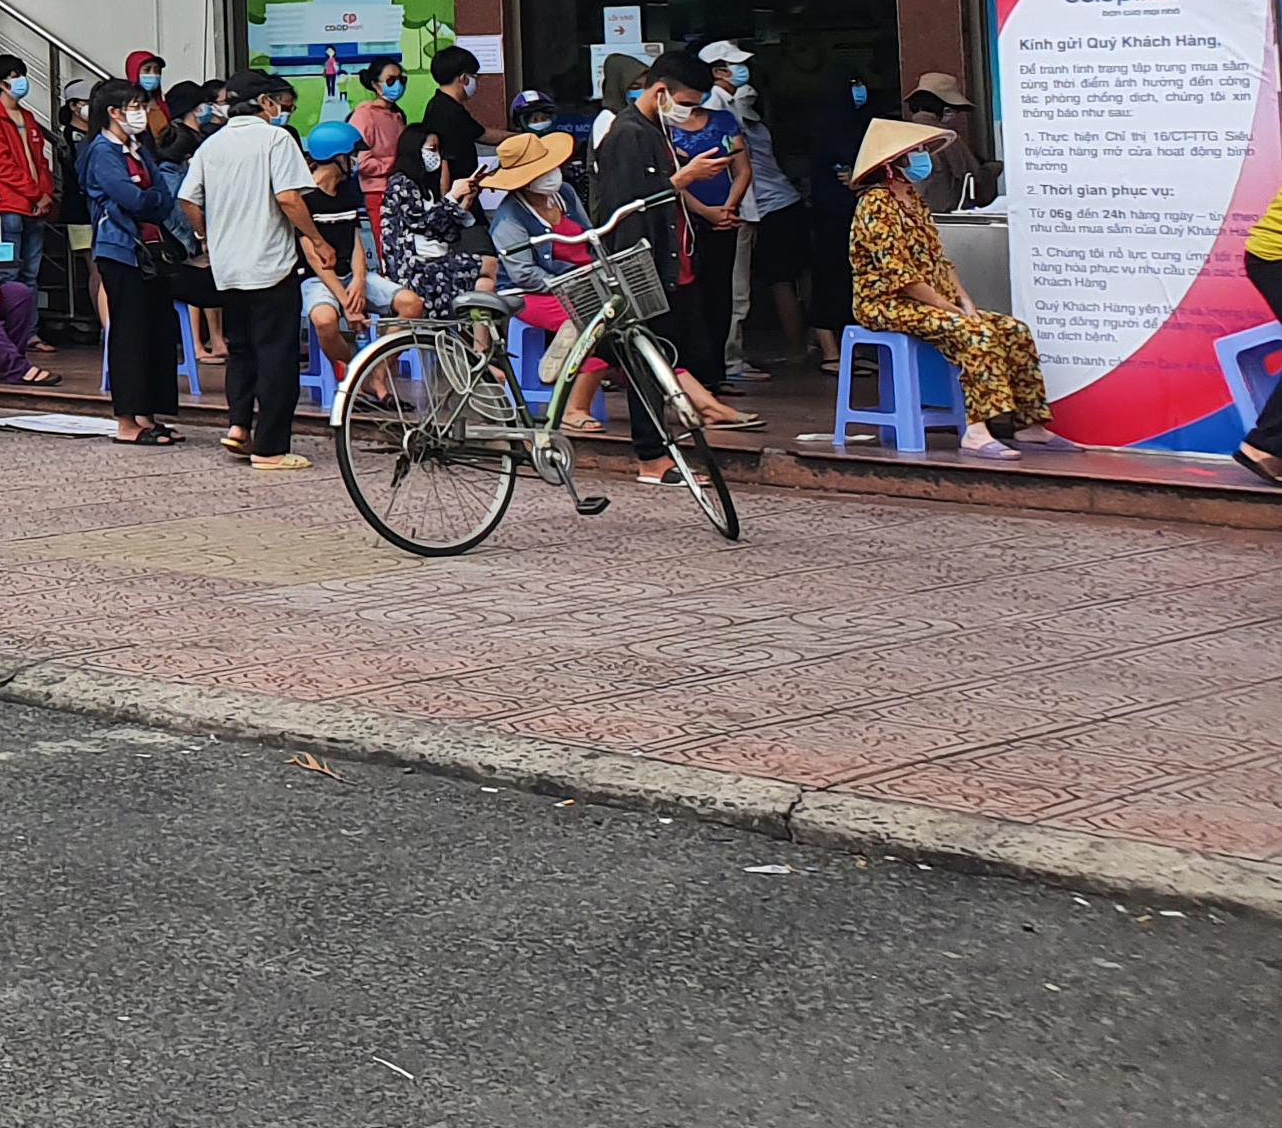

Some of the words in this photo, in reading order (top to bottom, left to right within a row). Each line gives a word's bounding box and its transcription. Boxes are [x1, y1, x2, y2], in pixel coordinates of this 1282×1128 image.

[1019, 38, 1053, 51] Kính
[1057, 37, 1082, 52] gửi
[1086, 36, 1117, 51] Quý
[1122, 36, 1171, 48] Khách
[1176, 34, 1222, 49] Hàng,
[1019, 62, 1036, 74] Để
[1132, 62, 1151, 75] tập
[1155, 63, 1186, 75] trung
[1191, 63, 1218, 72] mua
[1053, 78, 1075, 88] thời
[1142, 76, 1183, 89] hưởng
[1189, 75, 1213, 86] đến
[1219, 76, 1250, 89] công
[1044, 93, 1081, 106] phòng
[1086, 91, 1123, 105] chống
[1165, 91, 1204, 104] chúng
[1210, 91, 1226, 101] tôi
[1232, 91, 1251, 101] xin
[1022, 108, 1054, 120] thông
[1081, 108, 1105, 118] như
[1024, 132, 1035, 142] 1.
[1037, 131, 1068, 144] Thực
[1074, 131, 1099, 144] hiện
[1105, 131, 1126, 142] Chỉ
[1131, 131, 1146, 143] thị
[1069, 146, 1098, 159] hàng
[1190, 146, 1222, 159] động
[1025, 161, 1068, 173] thường
[1039, 184, 1073, 195] Thời
[1076, 184, 1108, 199] gian
[1111, 185, 1148, 199] phục
[1150, 187, 1175, 200] vụ:
[1029, 207, 1046, 219] Từ
[1049, 208, 1073, 221] 06g
[1076, 207, 1099, 219] đến
[1102, 209, 1126, 220] 24h
[1164, 210, 1194, 223] ngày
[1030, 223, 1052, 233] nhu
[1054, 221, 1076, 233] cầu
[1078, 225, 1104, 234] mua
[1106, 222, 1132, 234] sắm
[1159, 224, 1184, 238] Quý
[1187, 225, 1226, 236] Khách
[1046, 246, 1086, 260] Chúng
[1089, 248, 1104, 258] tôi
[1128, 250, 1148, 261] lực
[1151, 251, 1181, 263] cung
[1032, 261, 1062, 274] hàng
[1090, 263, 1119, 276] phục
[1121, 265, 1136, 276] vụ
[1138, 264, 1161, 275] nhu
[1163, 263, 1186, 276] cầu
[1033, 276, 1072, 287] Khách
[1075, 276, 1107, 290] Hàng
[1035, 299, 1059, 313] Quý
[1062, 301, 1100, 312] Khách
[1103, 302, 1136, 316] Hàng
[1138, 303, 1161, 316] yên
[1036, 315, 1066, 328] trung
[1069, 316, 1099, 329] đông
[1103, 317, 1139, 330] người
[1142, 317, 1158, 329] để
[1037, 329, 1055, 340] lan
[1057, 331, 1082, 343] dịch
[1038, 353, 1069, 365] Chân
